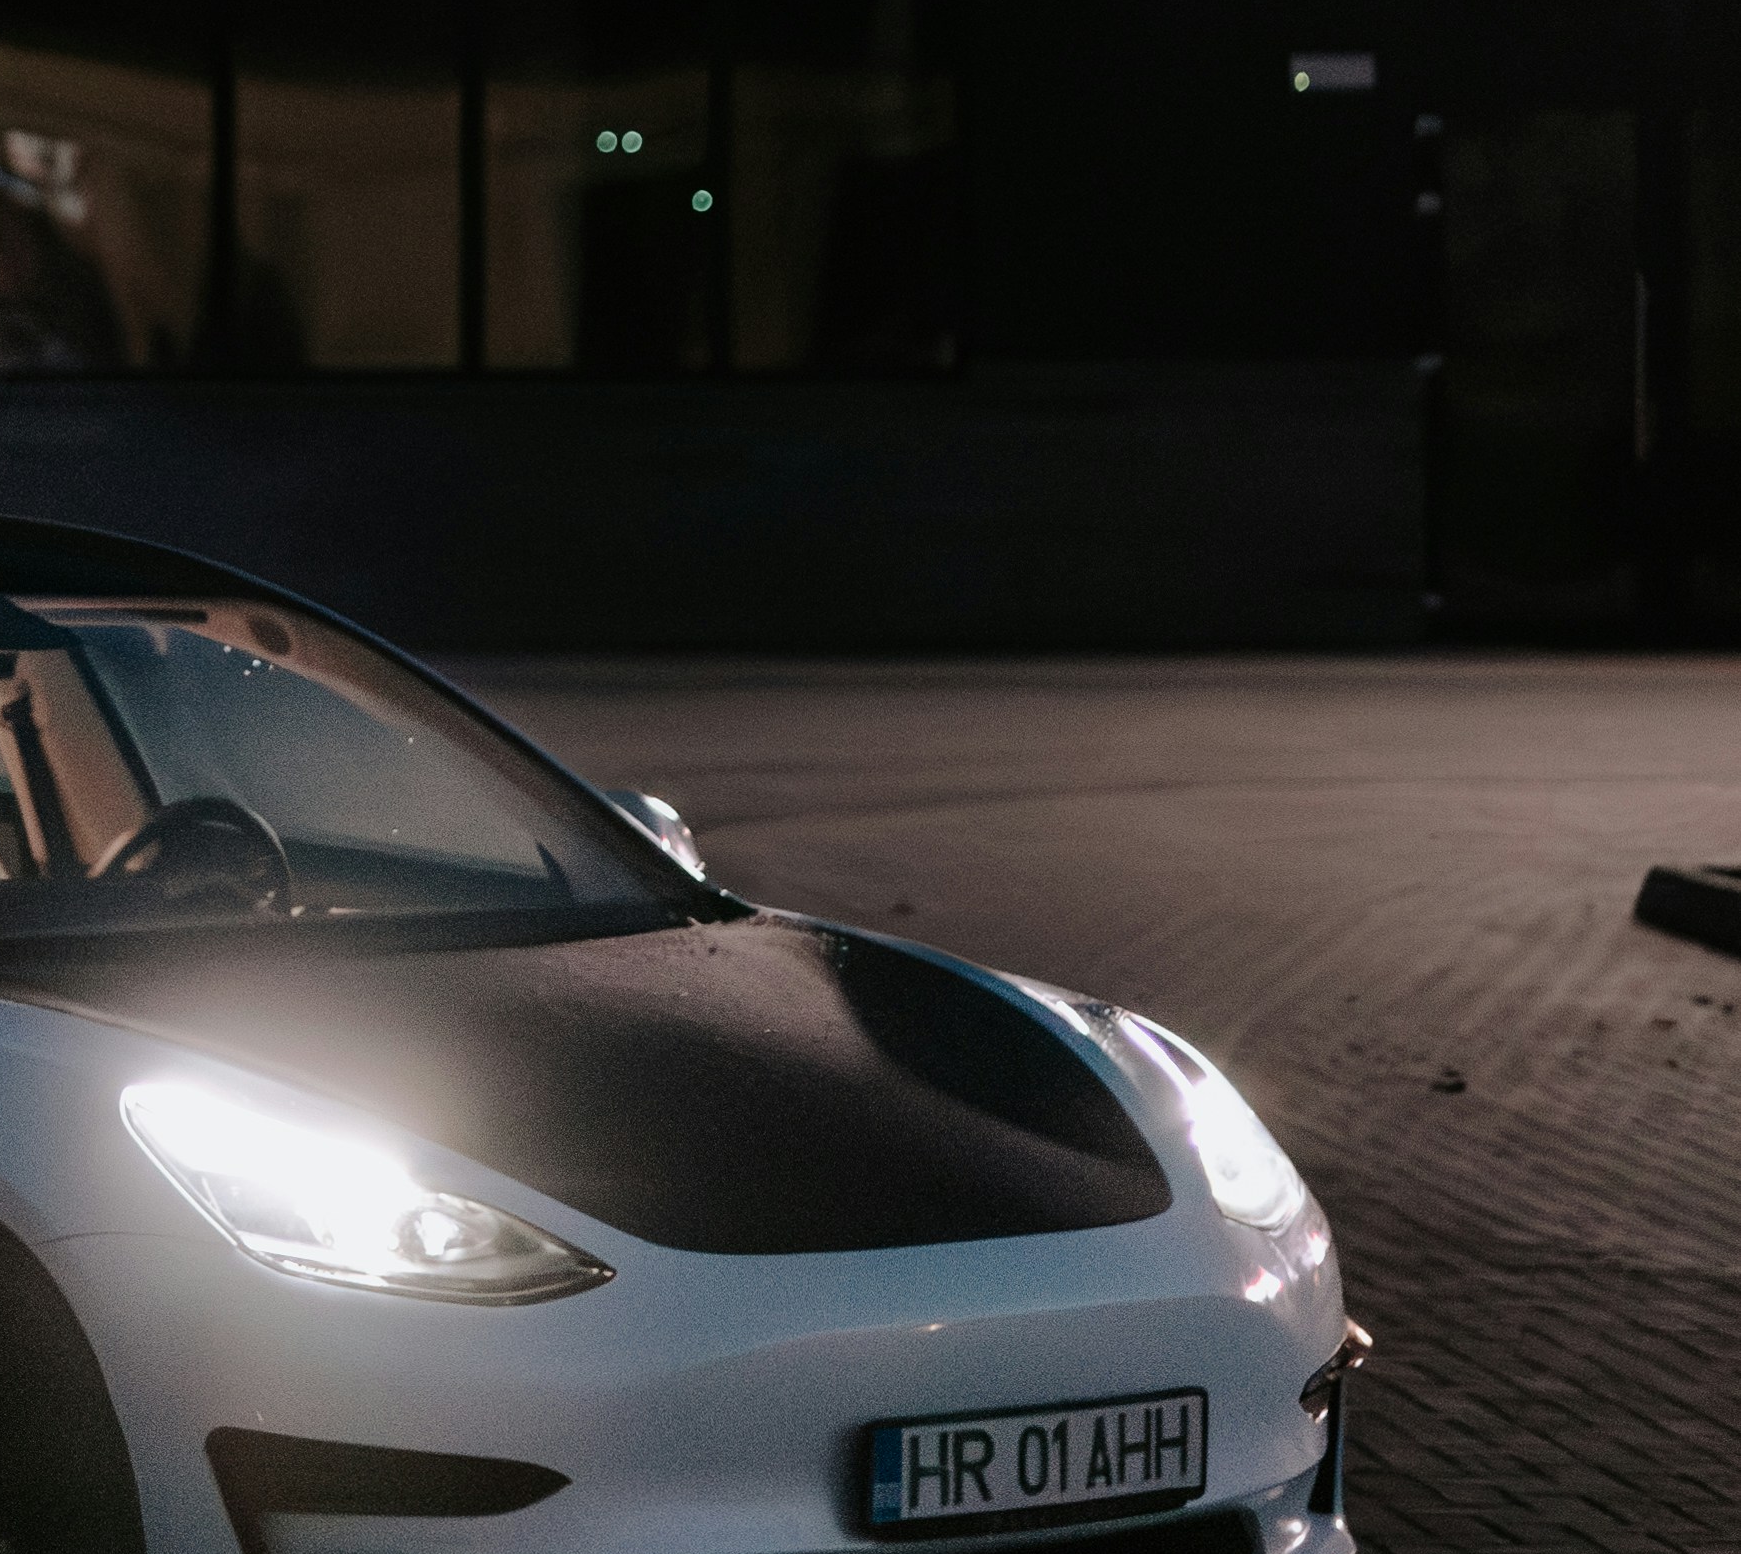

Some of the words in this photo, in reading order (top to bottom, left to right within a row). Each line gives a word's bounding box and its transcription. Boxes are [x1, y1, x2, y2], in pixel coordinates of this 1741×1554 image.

[906, 1427, 993, 1509] HR
[1017, 1417, 1070, 1496] 01
[1085, 1402, 1190, 1490] AHH
